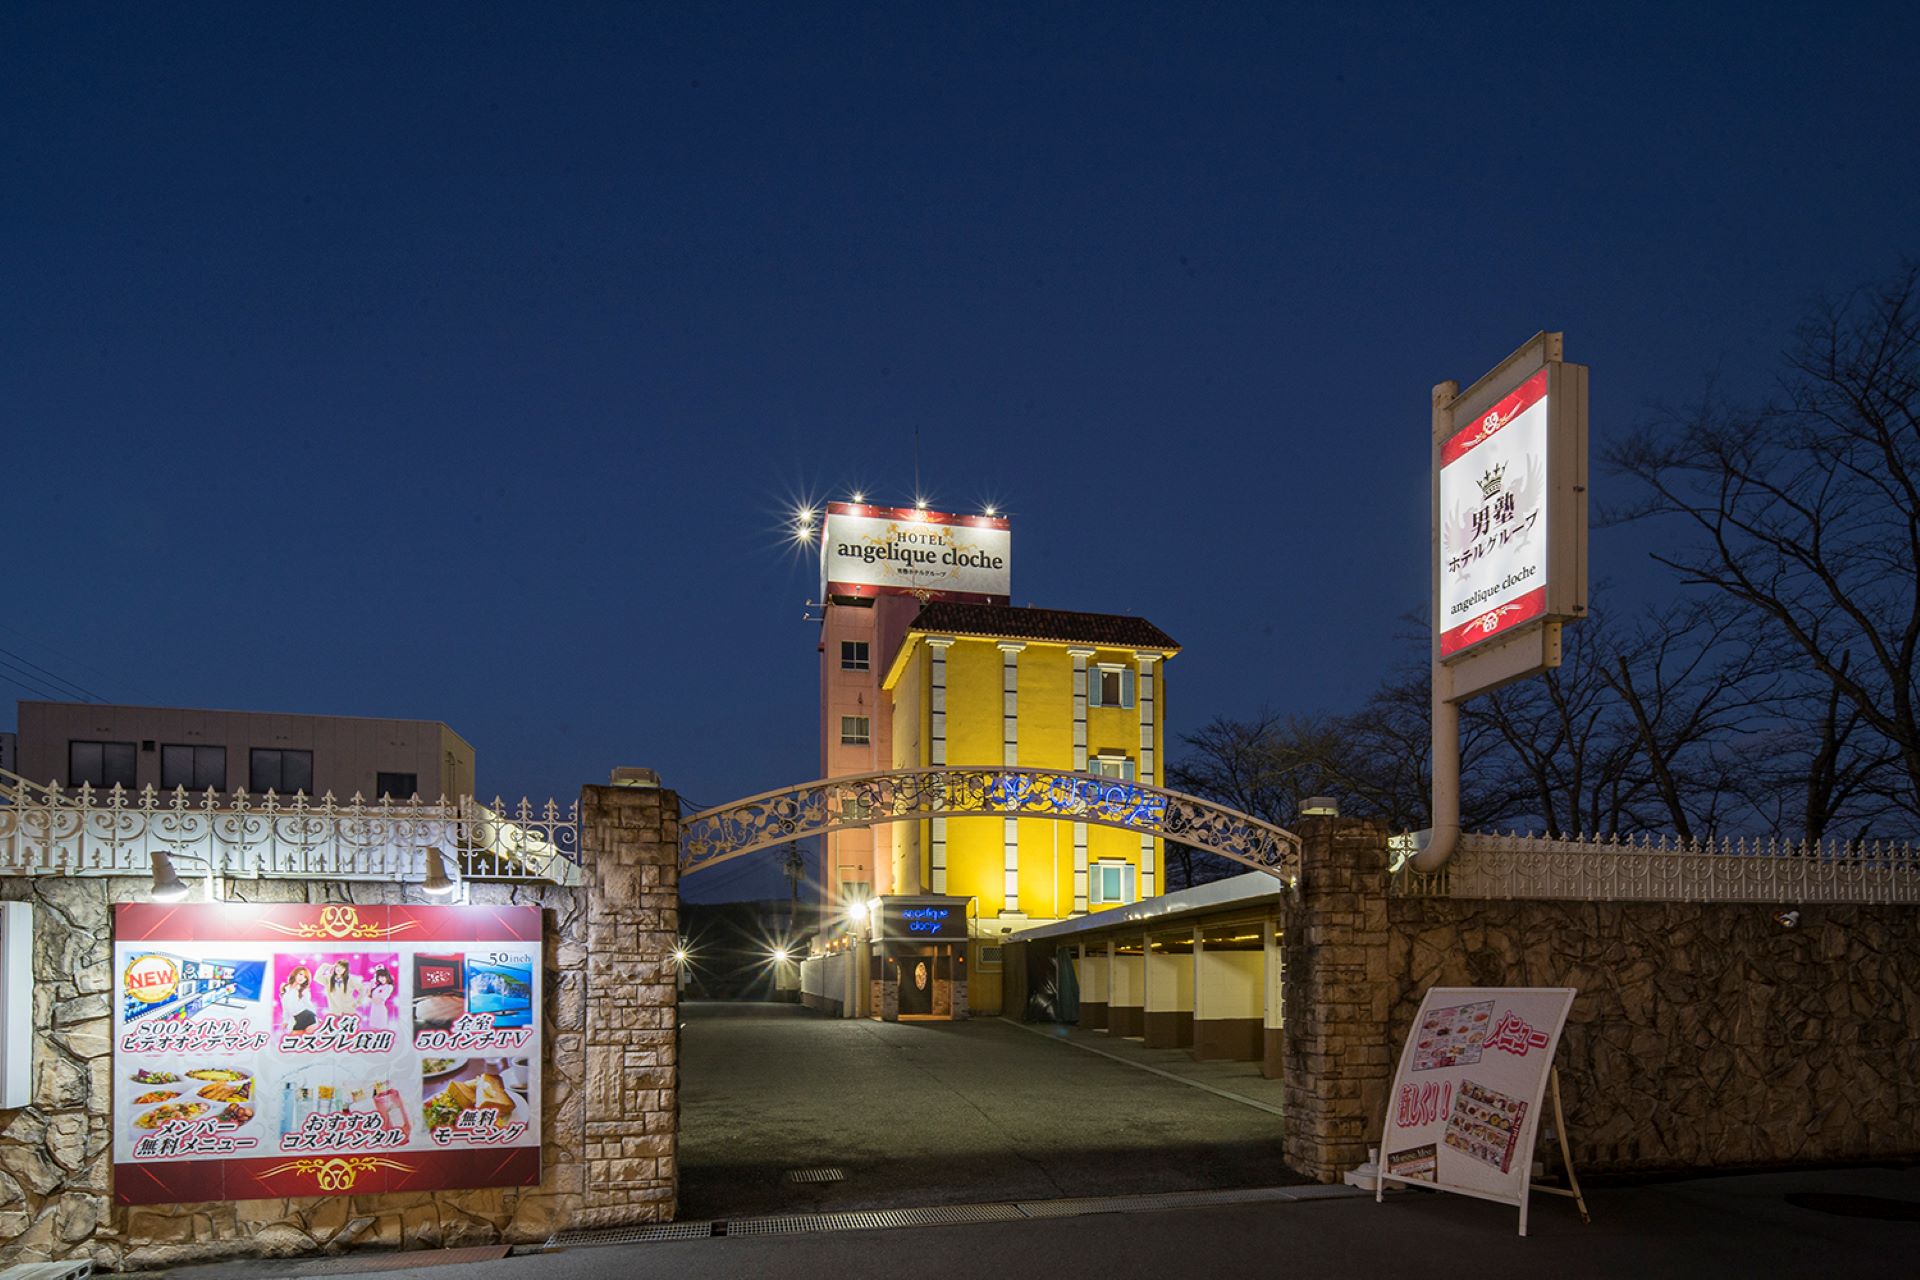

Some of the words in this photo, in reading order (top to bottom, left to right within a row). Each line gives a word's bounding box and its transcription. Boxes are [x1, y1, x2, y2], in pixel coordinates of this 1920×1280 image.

[1471, 491, 1515, 543] 男塾
[897, 532, 947, 546] HOTEL
[1448, 508, 1540, 573] ホテルグループ
[838, 542, 937, 567] angelique
[942, 548, 1003, 570] cloche
[1450, 584, 1501, 615] angelique
[1501, 565, 1537, 590] cloche
[128, 969, 175, 989] NEW
[321, 1016, 358, 1033] 人気
[457, 1015, 492, 1031] 全室
[282, 1033, 393, 1050] コスプレ貸出
[417, 1031, 531, 1048] 50インチTV
[1482, 1009, 1549, 1056] メニュー
[305, 1113, 382, 1131] おすすめ
[458, 1109, 497, 1127] 無料
[159, 1119, 236, 1136] メンバー
[434, 1124, 524, 1143] モーニング
[136, 1137, 254, 1155] 無料メニュー
[283, 1130, 404, 1149] コスメレンタル
